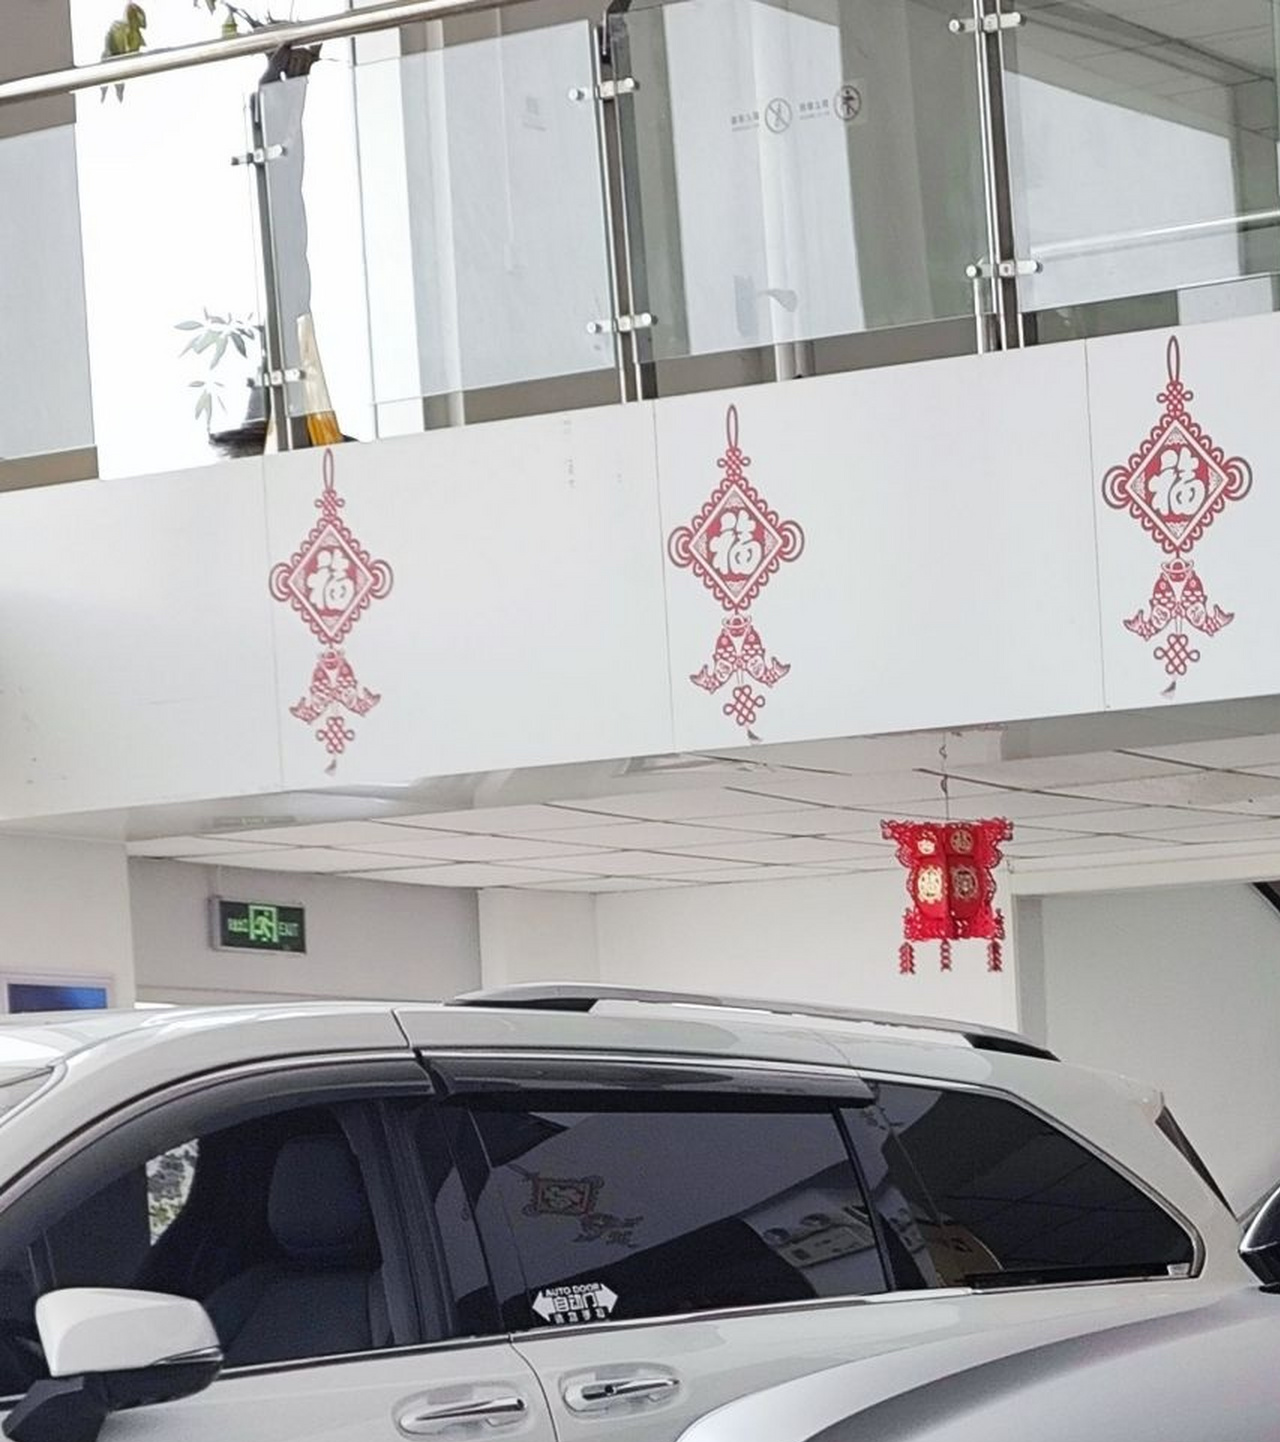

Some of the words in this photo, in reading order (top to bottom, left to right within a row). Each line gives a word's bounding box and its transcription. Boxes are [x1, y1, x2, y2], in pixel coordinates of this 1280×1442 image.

[1149, 447, 1205, 515] 福
[709, 510, 762, 575] 福
[307, 550, 355, 611] 福
[545, 1287, 571, 1297] AUTO
[572, 1282, 600, 1294] DOOR
[553, 1292, 598, 1312] 自动门
